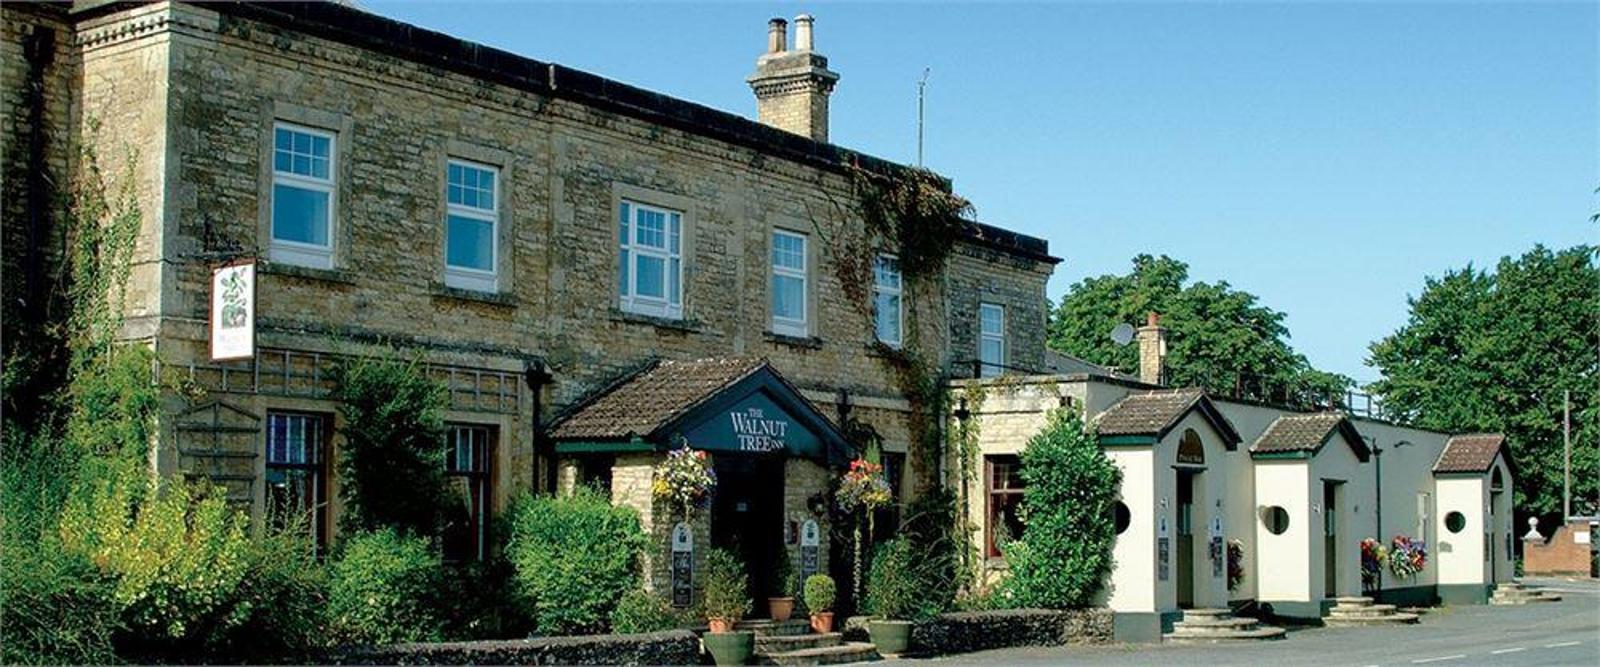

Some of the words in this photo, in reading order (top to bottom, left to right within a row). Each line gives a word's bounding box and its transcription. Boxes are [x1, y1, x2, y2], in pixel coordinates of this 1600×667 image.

[748, 408, 764, 418] THE
[730, 412, 788, 437] WALNUT
[737, 434, 772, 452] TREE
